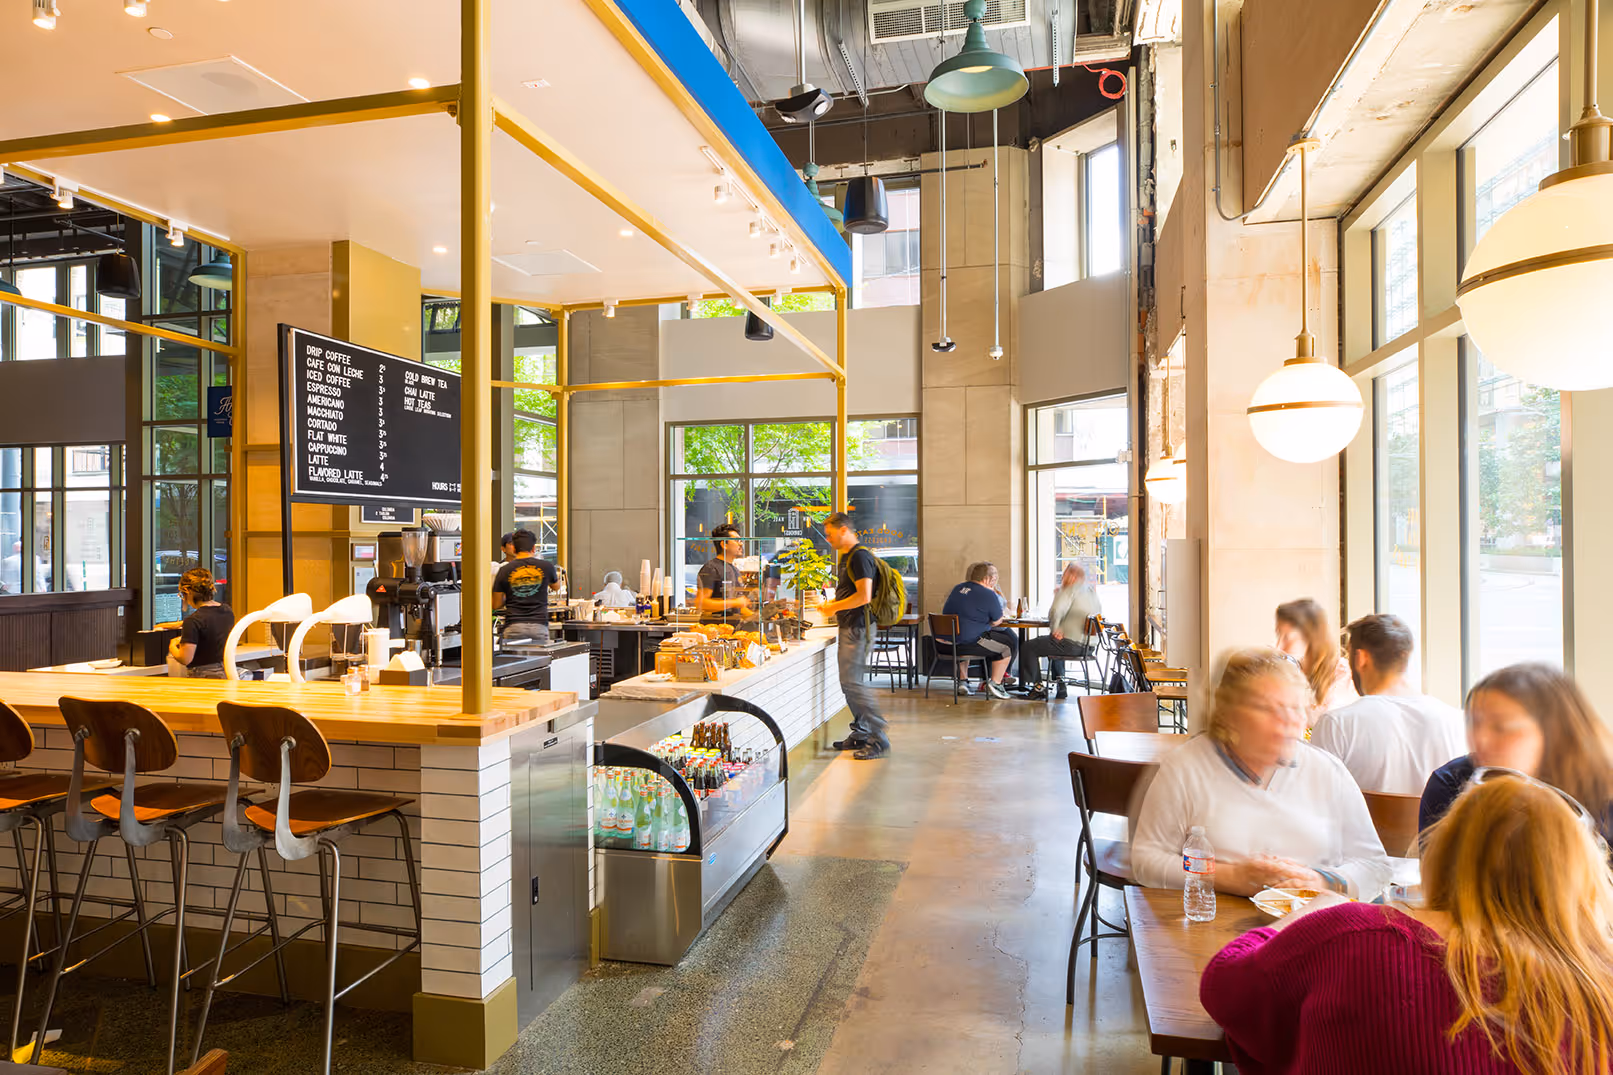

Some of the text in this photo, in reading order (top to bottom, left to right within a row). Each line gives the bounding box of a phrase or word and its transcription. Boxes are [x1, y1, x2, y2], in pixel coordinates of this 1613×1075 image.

[307, 345, 322, 357] DRIP
[325, 350, 351, 365] COFFEE
[307, 357, 384, 384] CAFE CON LECHE 3
[307, 369, 322, 381] ICED
[326, 374, 351, 388] COFFEE
[405, 371, 447, 389] COLD BREW TEA
[307, 382, 384, 406] ESPRESSO 3
[404, 386, 435, 401] CHAI LATTE
[307, 394, 384, 416] AMERICANO 3
[404, 396, 431, 410] HOT TEAS
[307, 406, 343, 421] MACCHIATO
[307, 418, 337, 431] CORTADO
[308, 430, 324, 442] FLAT
[328, 433, 347, 445] WHITE
[308, 442, 347, 456] CAPPUCCINO
[308, 454, 384, 471] LATTE 4
[308, 466, 341, 478] FLAVORED
[344, 470, 363, 482] LATTE
[432, 482, 448, 491] HOURS
